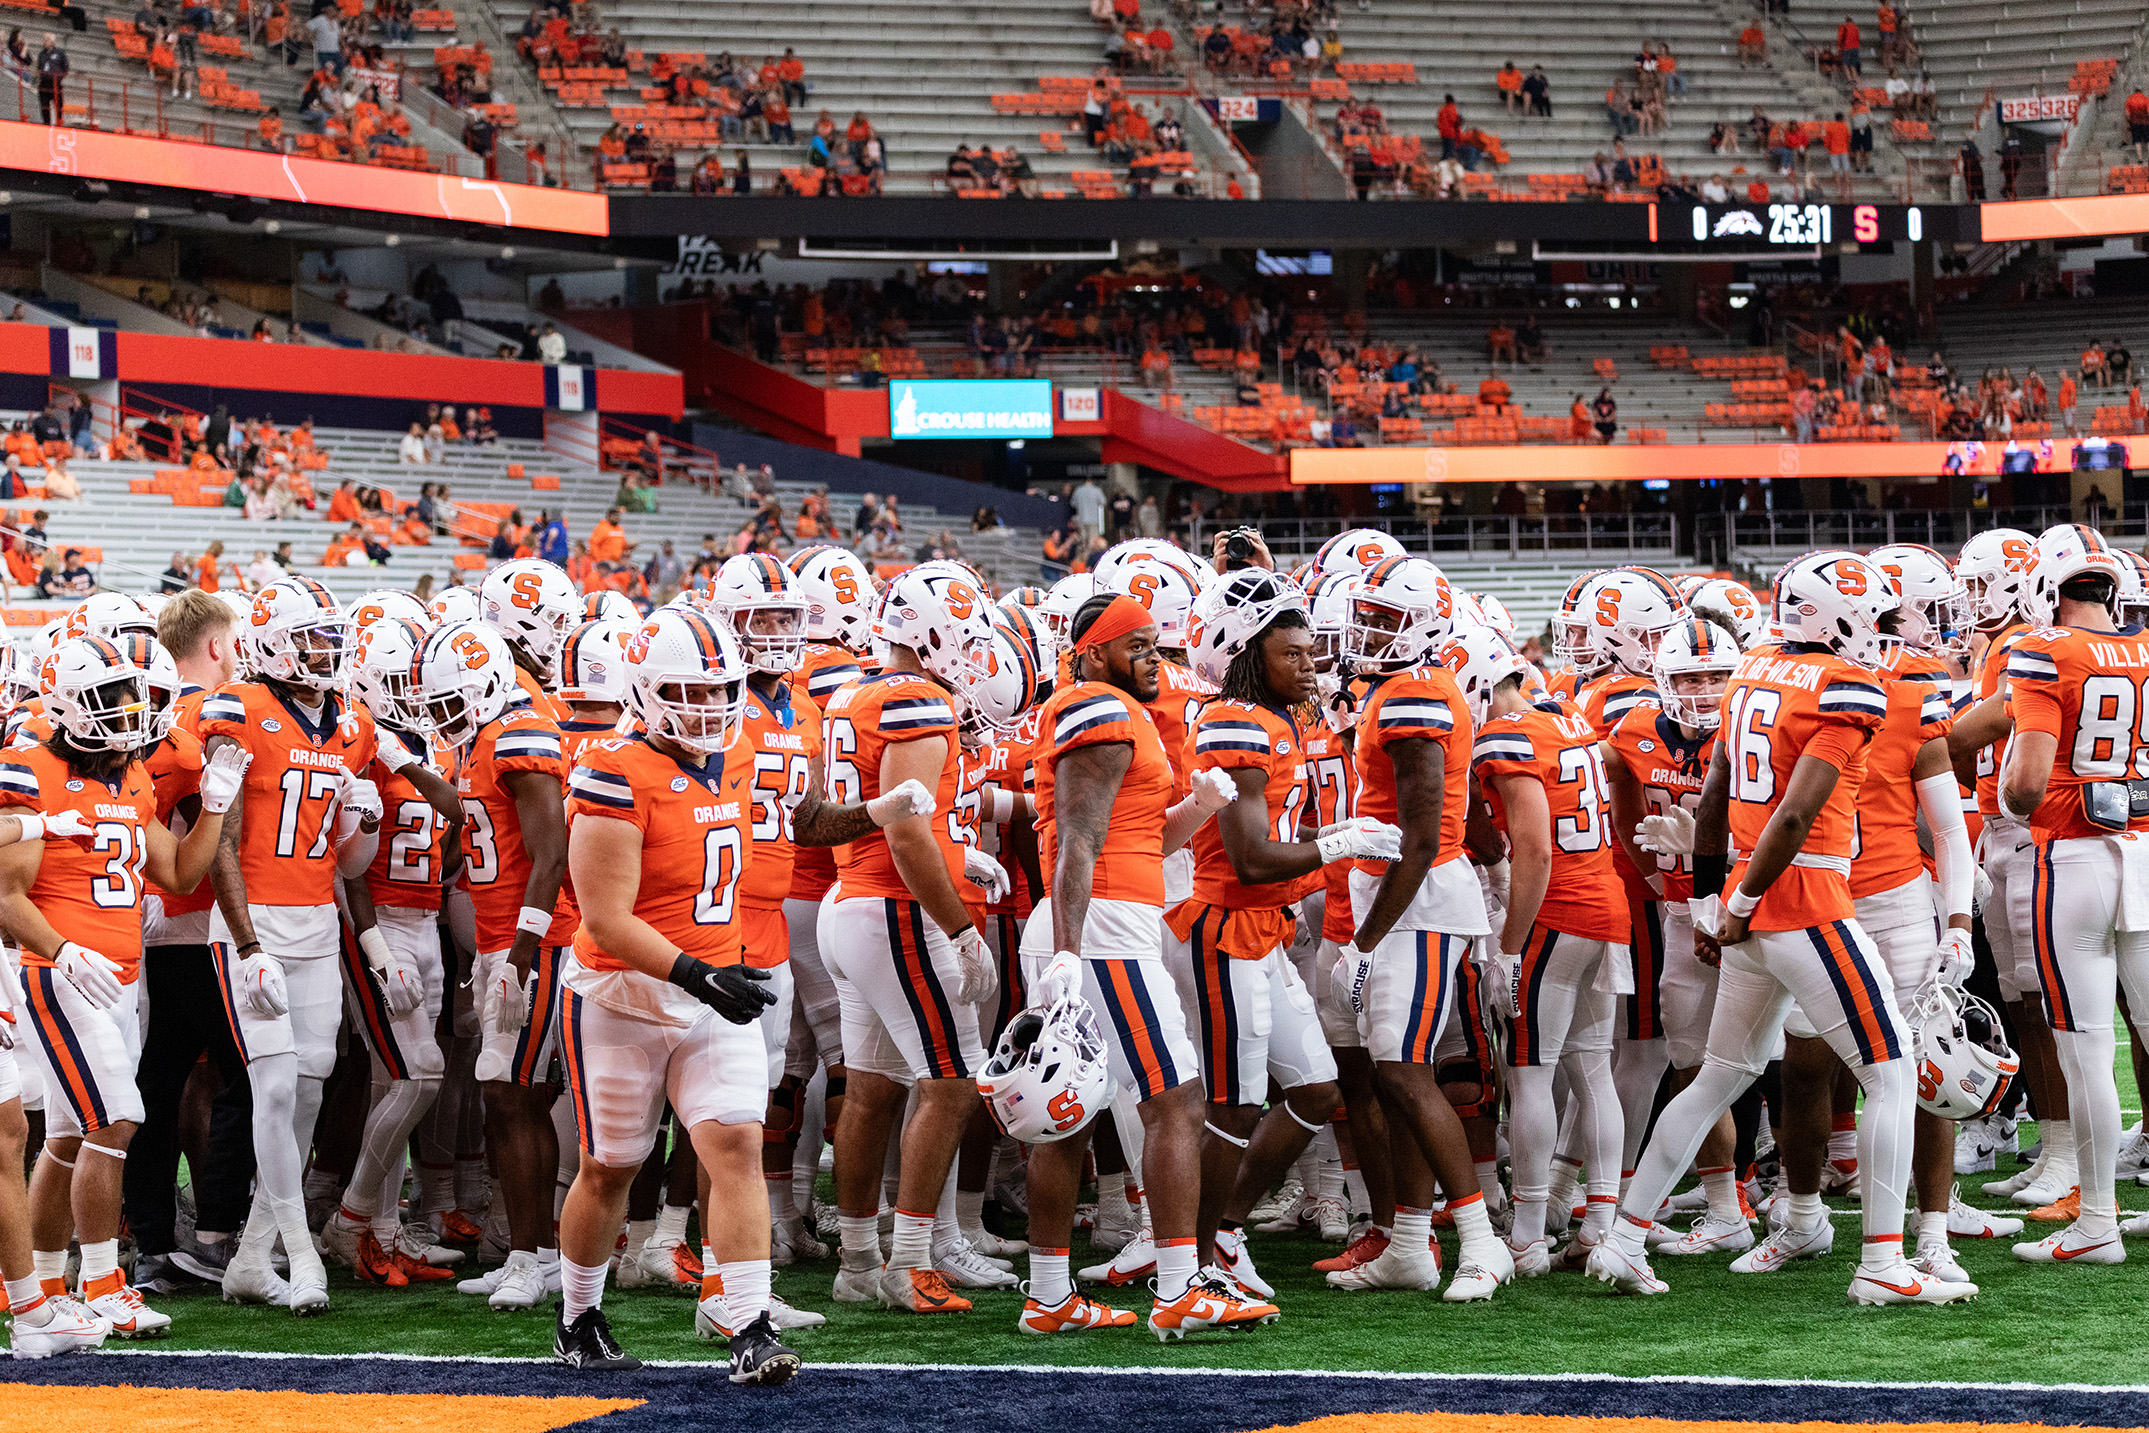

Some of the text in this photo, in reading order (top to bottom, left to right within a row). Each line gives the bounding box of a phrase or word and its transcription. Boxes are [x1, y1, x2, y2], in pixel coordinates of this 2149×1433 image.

[1220, 101, 1255, 117] 324
[2003, 102, 2040, 119] 325
[1692, 203, 1922, 243] 0 25:31 S 0
[74, 344, 94, 362] 118
[917, 411, 1052, 430] CROUSE HEALTH
[1067, 397, 1095, 412] 120
[511, 572, 544, 609] S
[830, 564, 859, 605] S
[1128, 573, 1159, 611] S
[1835, 558, 1868, 597] S
[251, 589, 277, 627] S
[944, 580, 977, 621] S
[1435, 576, 1453, 620] S
[1596, 587, 1623, 627] S
[1725, 586, 1755, 620] S
[451, 631, 490, 671] S
[627, 622, 660, 665] S
[1440, 639, 1470, 674] S
[40, 653, 60, 695] S
[1410, 667, 1432, 681] 11
[263, 720, 281, 730] ACC
[312, 734, 322, 748] S
[763, 731, 804, 751] ORANGE
[289, 748, 345, 769] ORANGE
[1674, 749, 1684, 763] S
[1727, 684, 1781, 805] 16
[673, 779, 688, 788] ACC
[707, 778, 718, 795] S
[94, 802, 139, 821] ORANGE
[274, 767, 346, 860] 17
[693, 801, 742, 824] ORANGE
[91, 821, 147, 909] 31
[692, 824, 743, 926] 0
[1350, 958, 1371, 1015] SYRACUSE
[1047, 1089, 1085, 1132] S
